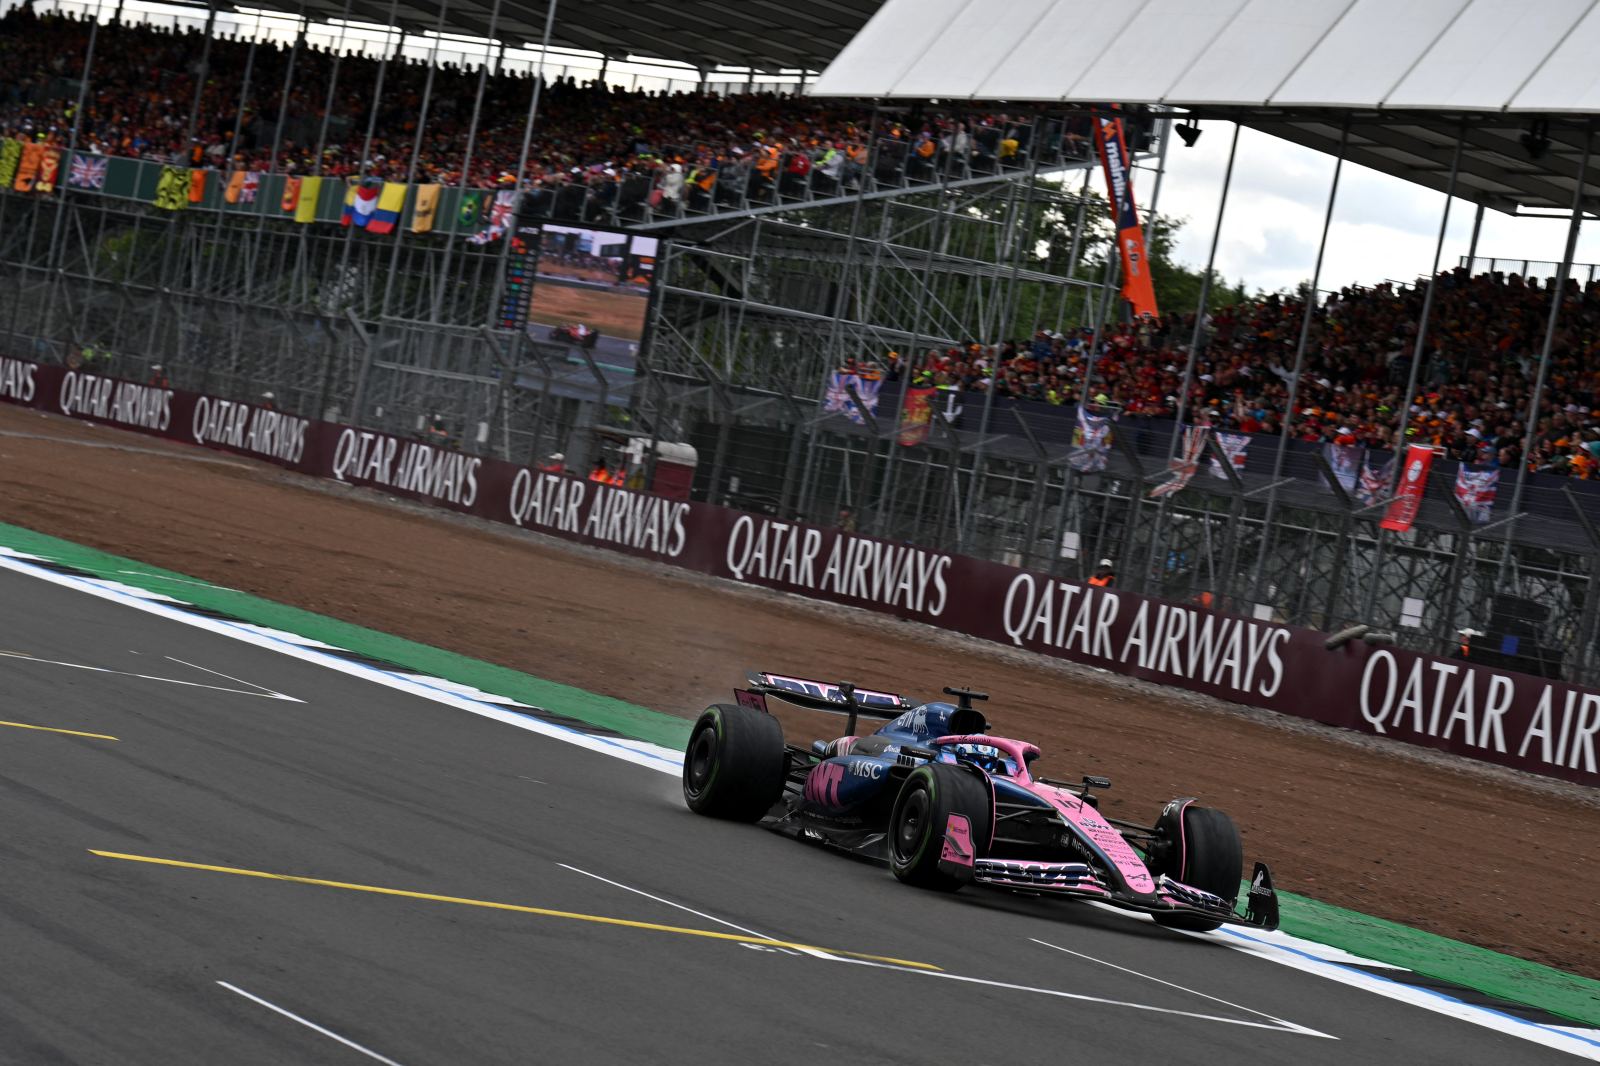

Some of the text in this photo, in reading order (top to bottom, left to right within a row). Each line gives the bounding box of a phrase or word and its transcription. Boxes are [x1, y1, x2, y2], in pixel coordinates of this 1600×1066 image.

[60, 371, 113, 418] QATAR
[192, 396, 249, 448] QATAR
[333, 429, 482, 506] QATAR AIRWAYS
[509, 469, 690, 557] QATAR AIRWAYS
[726, 515, 952, 616] QATAR AIRWAYS
[1002, 573, 1290, 697] QATAR AIRWAYS
[1359, 649, 1600, 774] QATAR AIR
[854, 761, 883, 779] MSC
